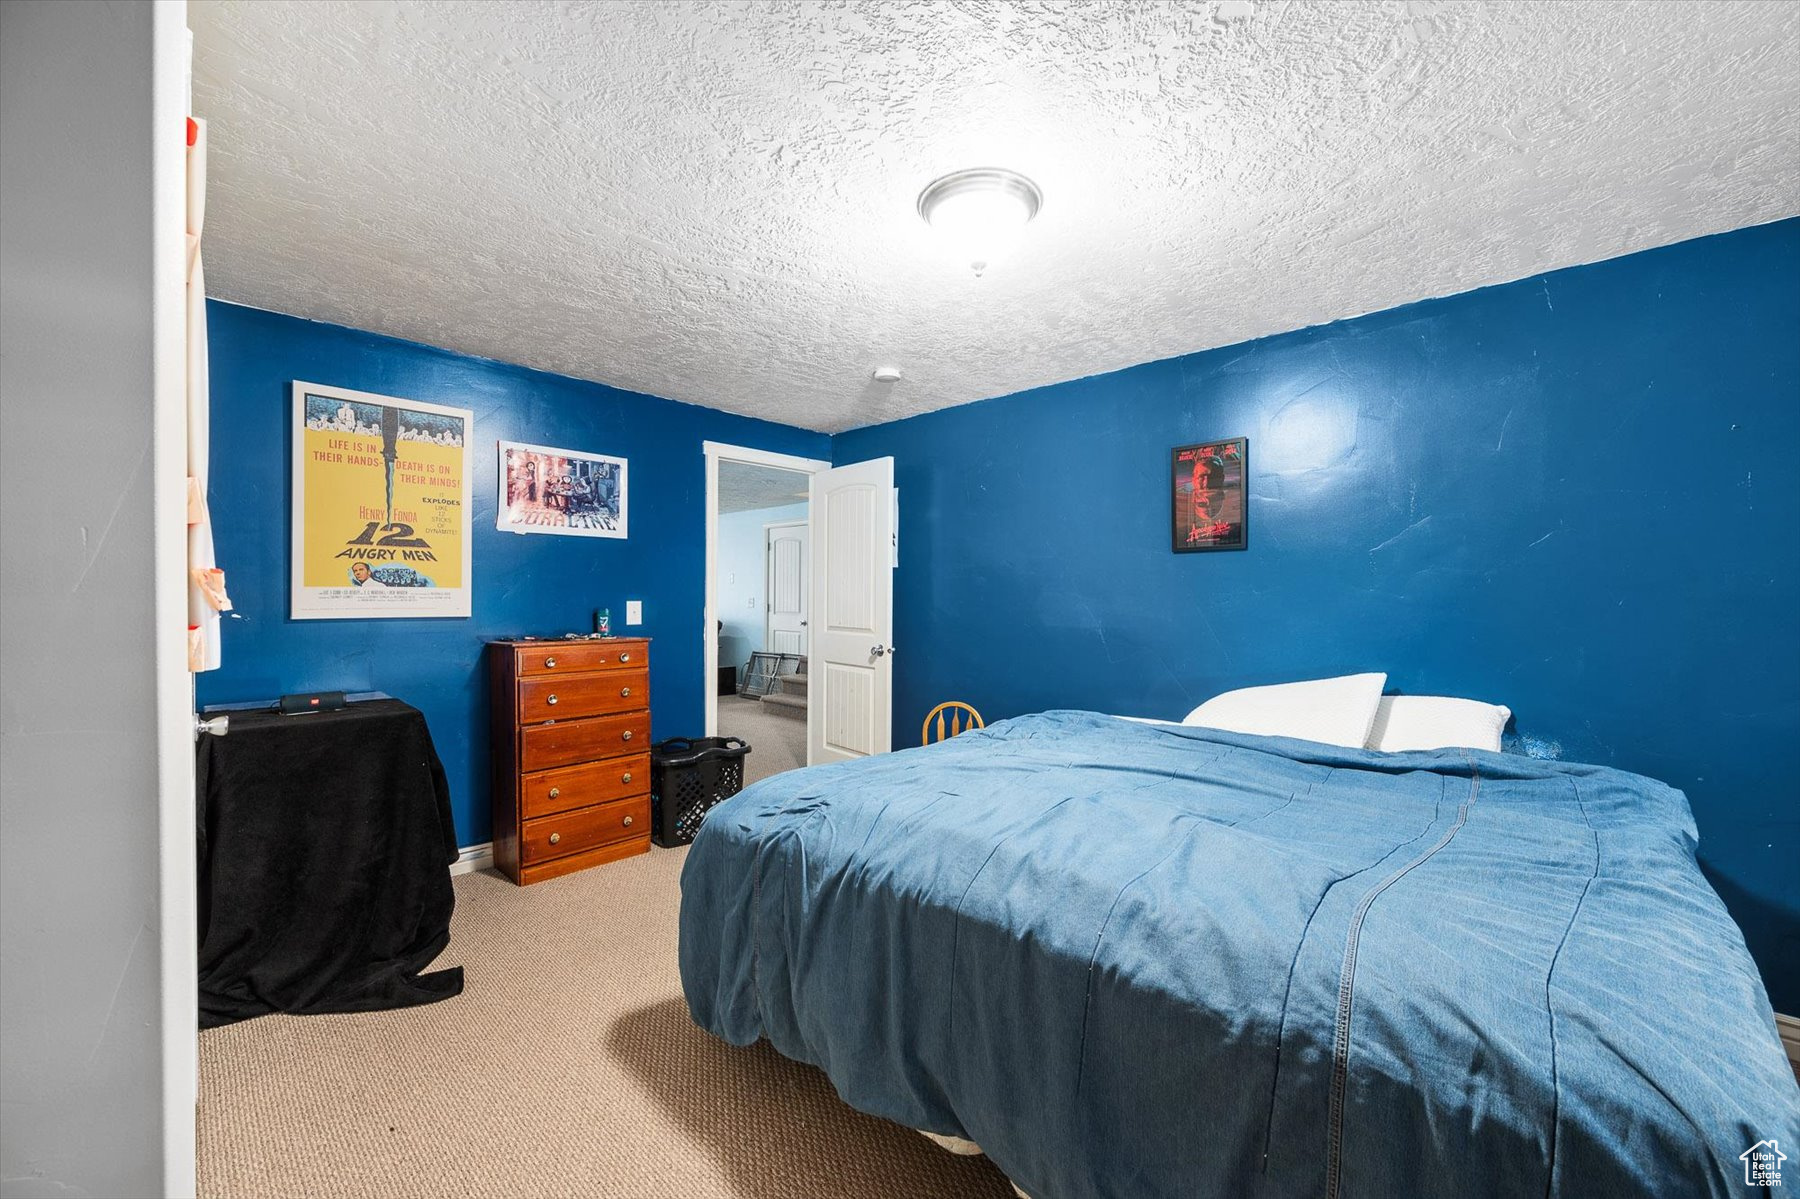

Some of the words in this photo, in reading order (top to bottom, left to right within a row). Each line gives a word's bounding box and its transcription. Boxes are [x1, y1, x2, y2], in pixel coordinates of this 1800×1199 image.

[328, 438, 349, 451] LIFE
[353, 441, 363, 452] IS
[366, 443, 377, 453] IN
[313, 450, 343, 464] THEIR
[396, 460, 424, 472] DEATH
[426, 463, 435, 473] IS
[438, 464, 451, 475] ON
[400, 473, 426, 485] THEIR
[429, 476, 461, 489] MINDS!
[422, 497, 461, 506] EXPLODES
[359, 505, 385, 521] HENRY
[393, 509, 418, 523] FONDA
[345, 521, 433, 549] 12
[334, 547, 396, 560] ANGRY
[403, 549, 438, 562] MEN
